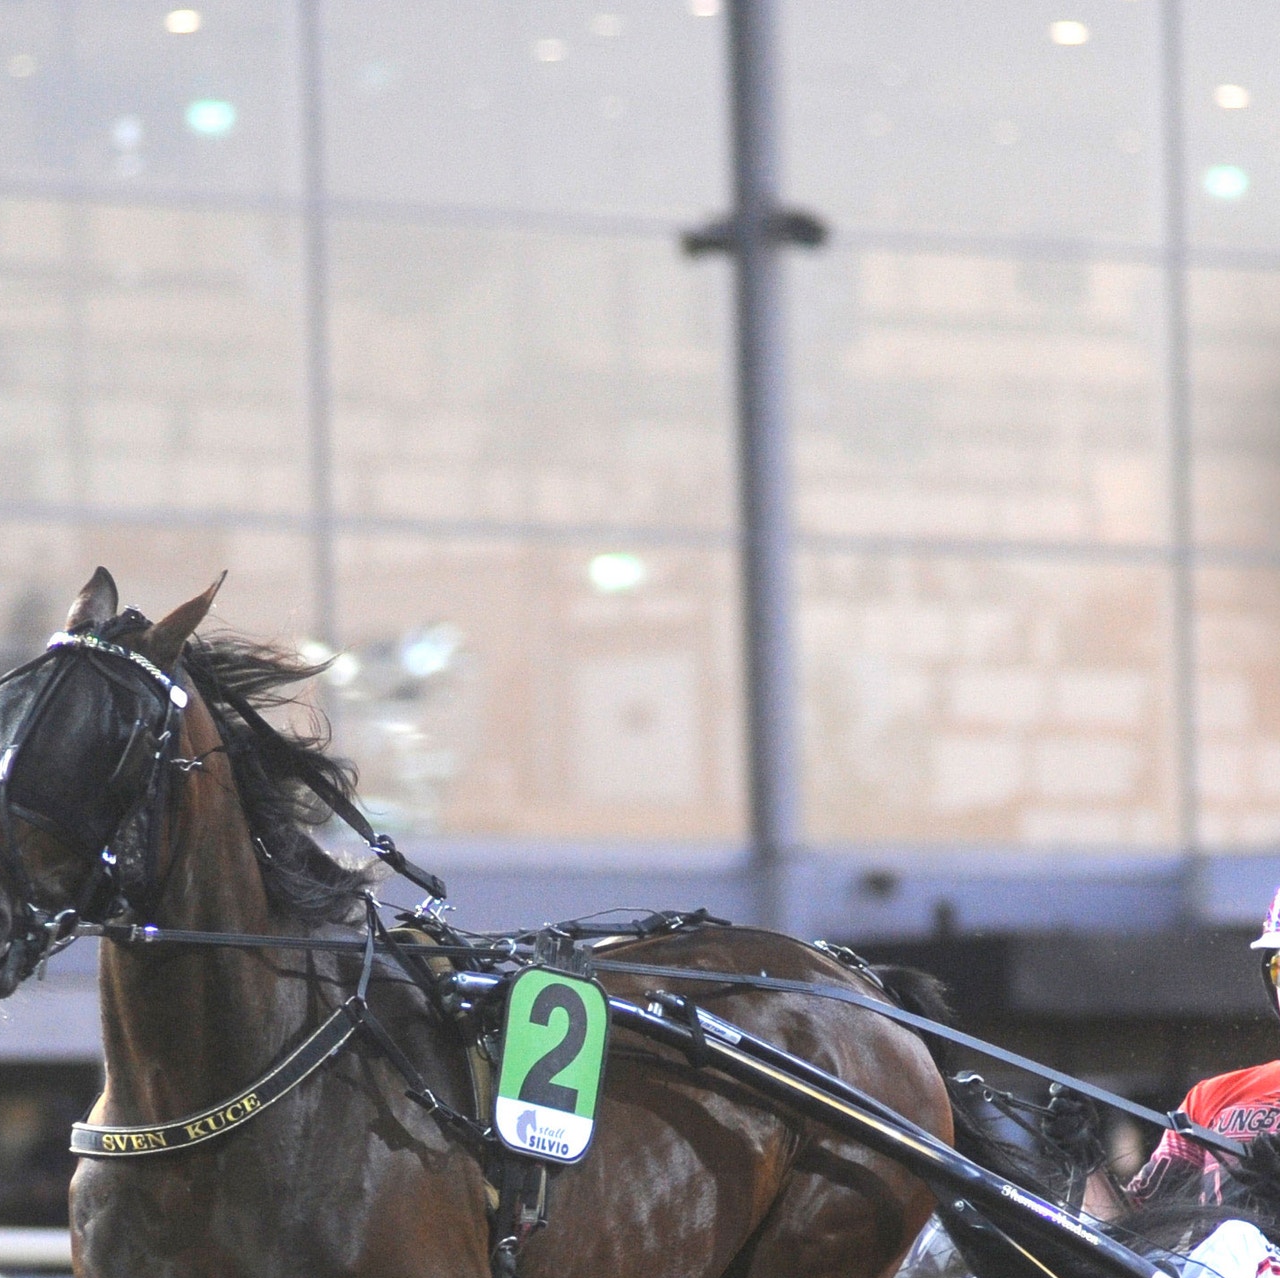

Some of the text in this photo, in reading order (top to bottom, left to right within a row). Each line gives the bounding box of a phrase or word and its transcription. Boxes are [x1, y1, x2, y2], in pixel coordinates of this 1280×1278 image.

[518, 983, 587, 1113] 2
[102, 1093, 261, 1151] SVEN KUCE
[539, 1127, 565, 1139] stall
[529, 1135, 569, 1155] SILVIO
